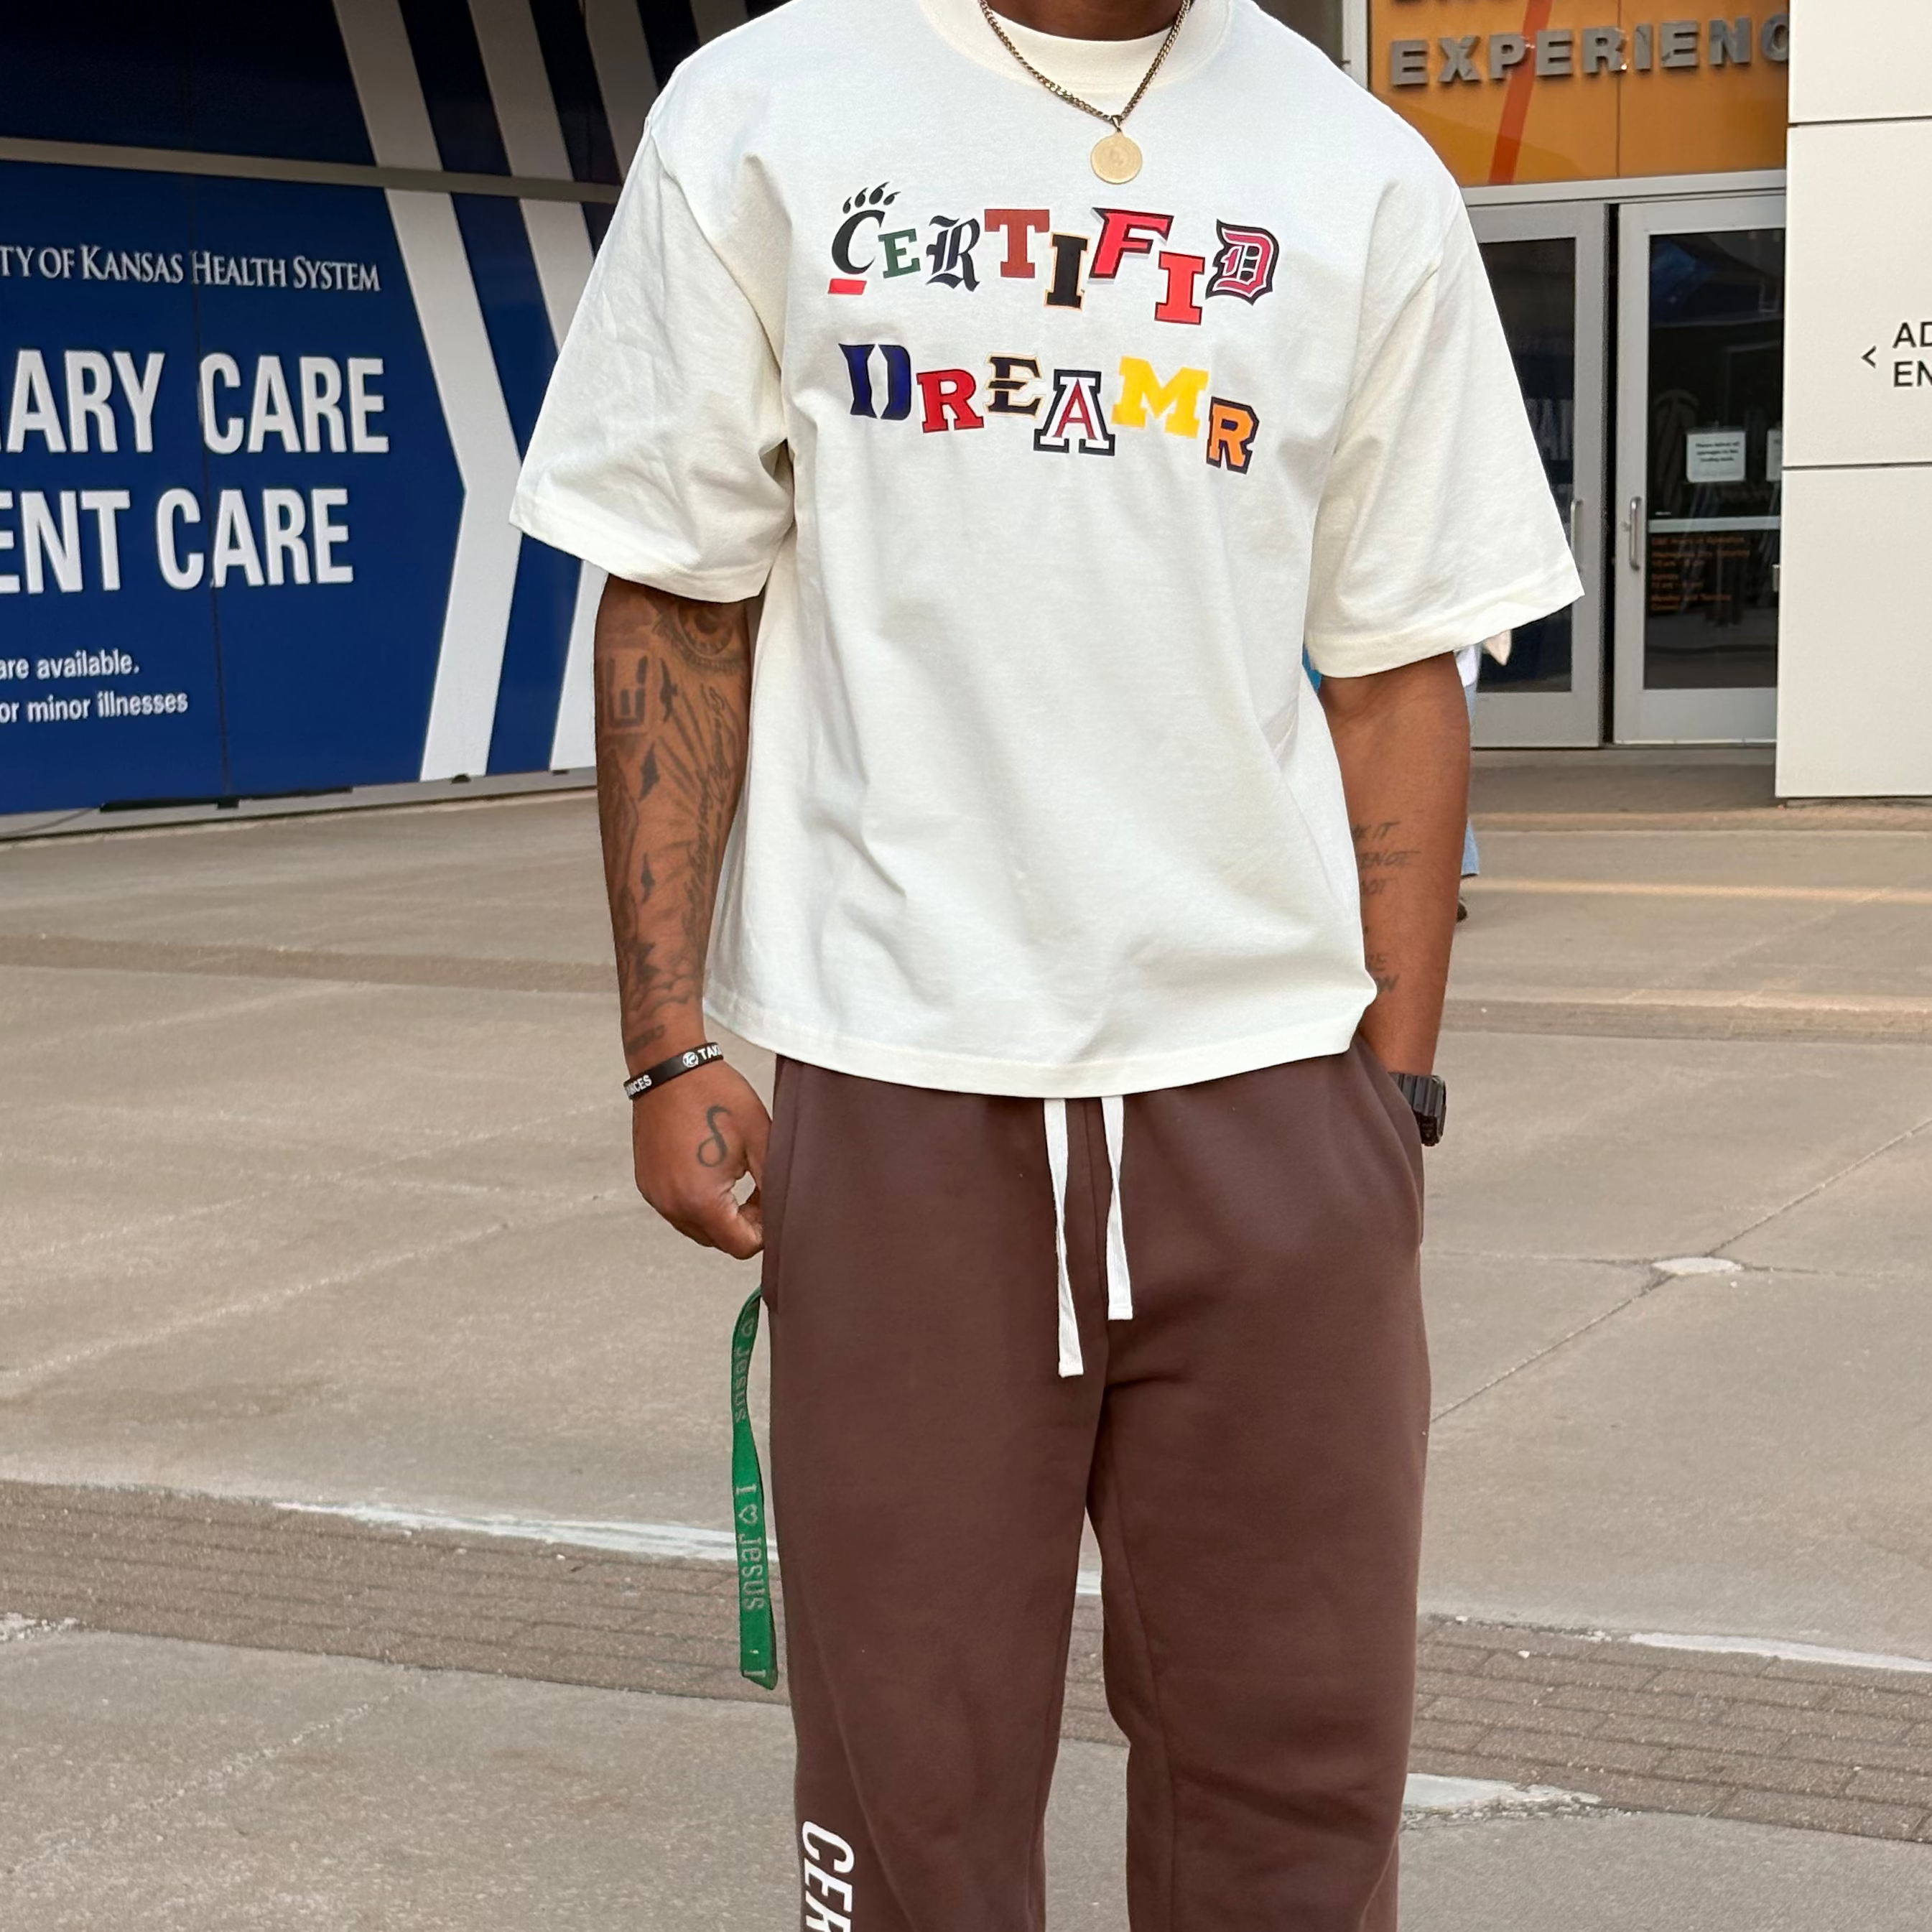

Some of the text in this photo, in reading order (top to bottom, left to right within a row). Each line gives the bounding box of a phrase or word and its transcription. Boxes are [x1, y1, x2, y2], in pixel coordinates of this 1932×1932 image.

[39, 247, 75, 279] OF
[80, 243, 184, 283] KANSAS
[191, 251, 287, 287] HEALTH
[292, 256, 381, 291] SYSTEM
[6, 350, 389, 453] ARY CARE
[838, 343, 1260, 475] DREAMR
[157, 488, 353, 590] CARE
[0, 648, 139, 680] are available.
[28, 695, 91, 723] minor
[97, 690, 188, 717] illnesses
